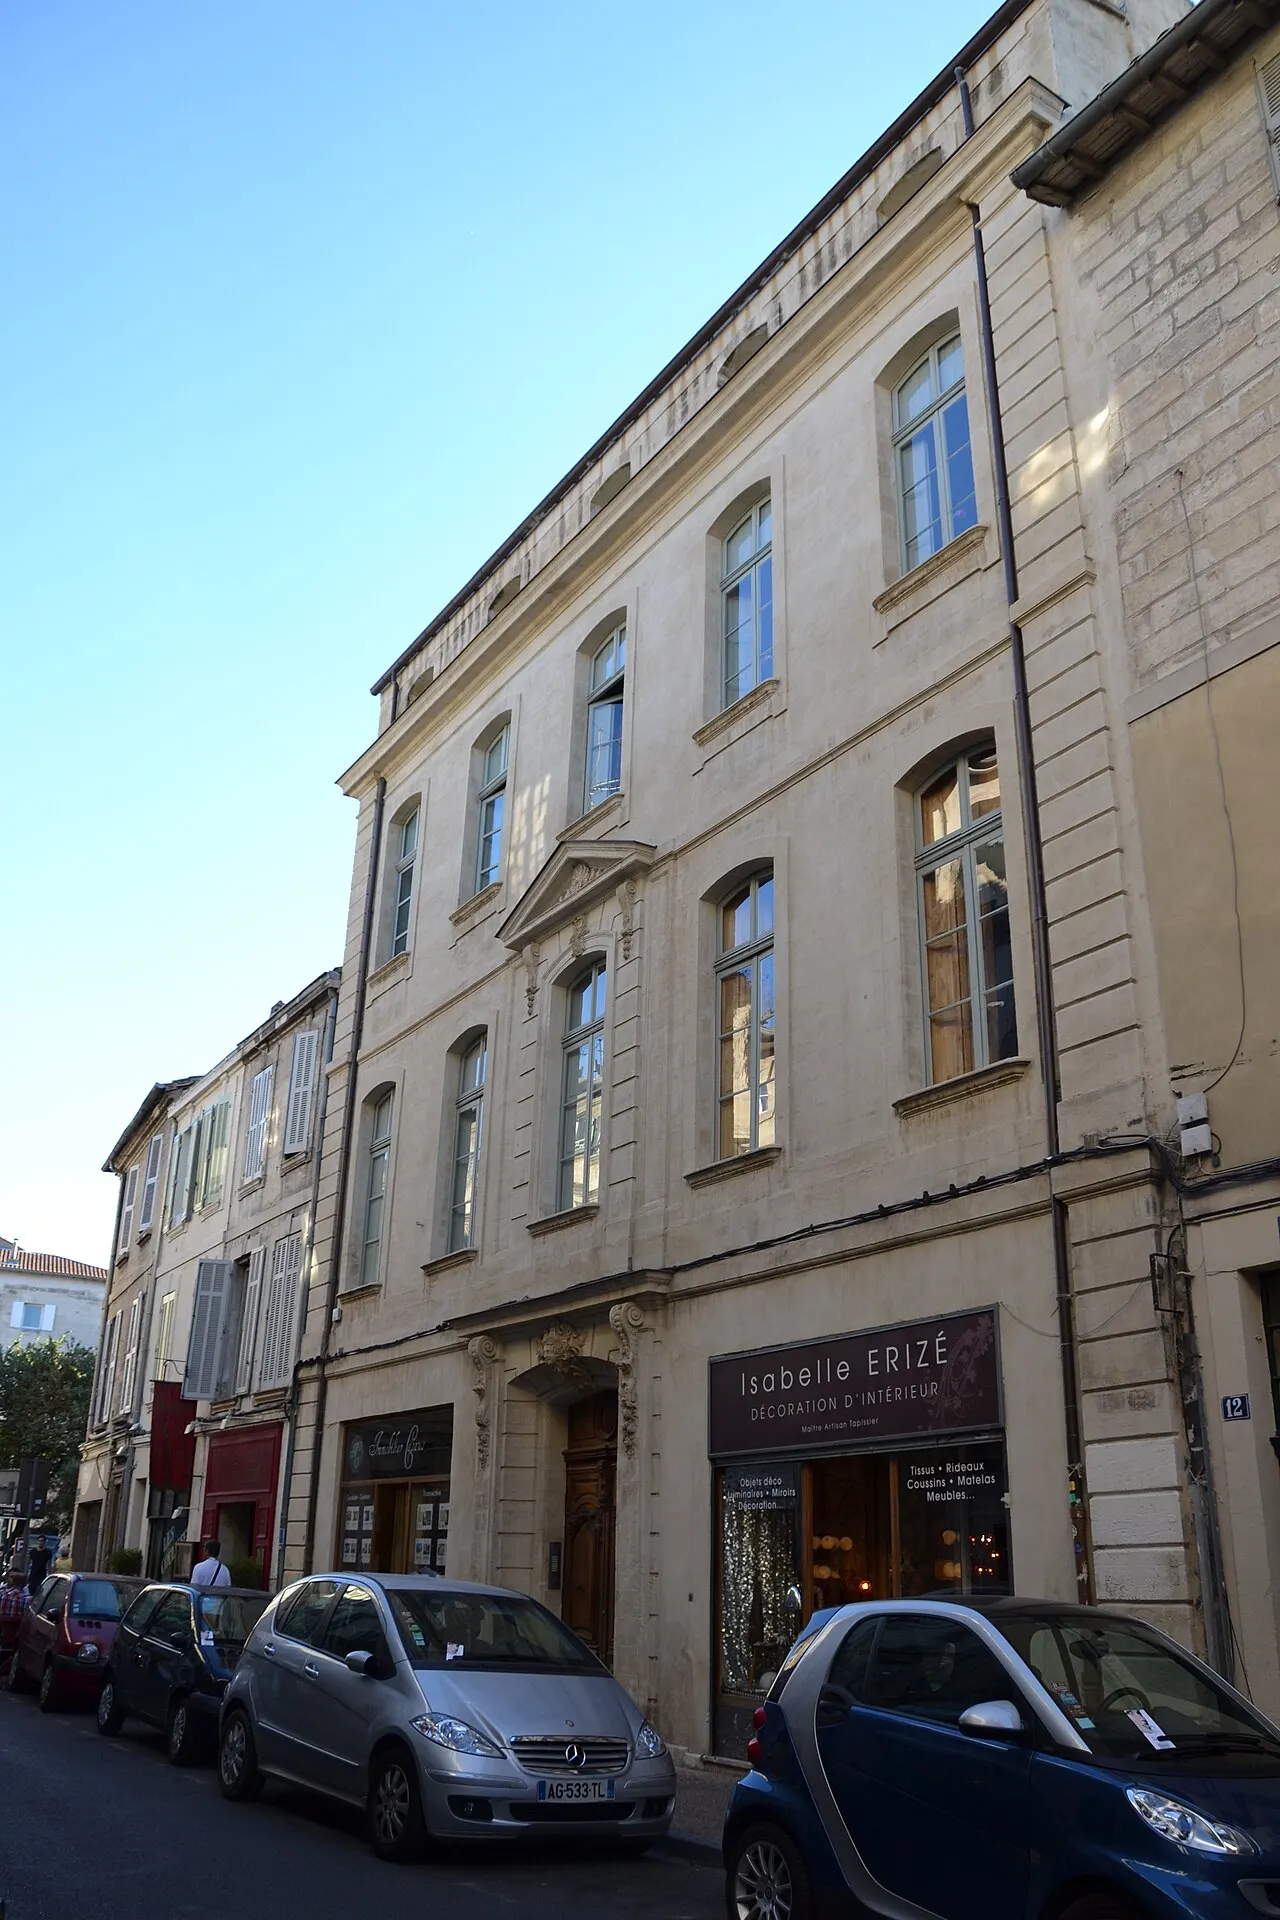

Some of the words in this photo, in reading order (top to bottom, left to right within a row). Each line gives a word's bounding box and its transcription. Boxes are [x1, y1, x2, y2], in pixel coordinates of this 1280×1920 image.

[741, 1358, 850, 1396] Isabelle
[868, 1330, 948, 1376] ERIZÉ
[751, 1396, 838, 1421] DÉCORATION
[844, 1381, 939, 1409] D'INTÉRIEUR
[1225, 1397, 1244, 1418] 12
[824, 1421, 848, 1430] Artisan
[849, 1417, 880, 1428] Tapissier
[910, 1465, 935, 1476] Tissus
[946, 1462, 985, 1473] Rideaux
[739, 1477, 762, 1488] Objets
[763, 1475, 783, 1486] déco
[907, 1478, 946, 1490] Coussins
[957, 1474, 996, 1486] Matelas
[727, 1489, 764, 1500] Luminaires
[771, 1487, 797, 1498] Miroirs
